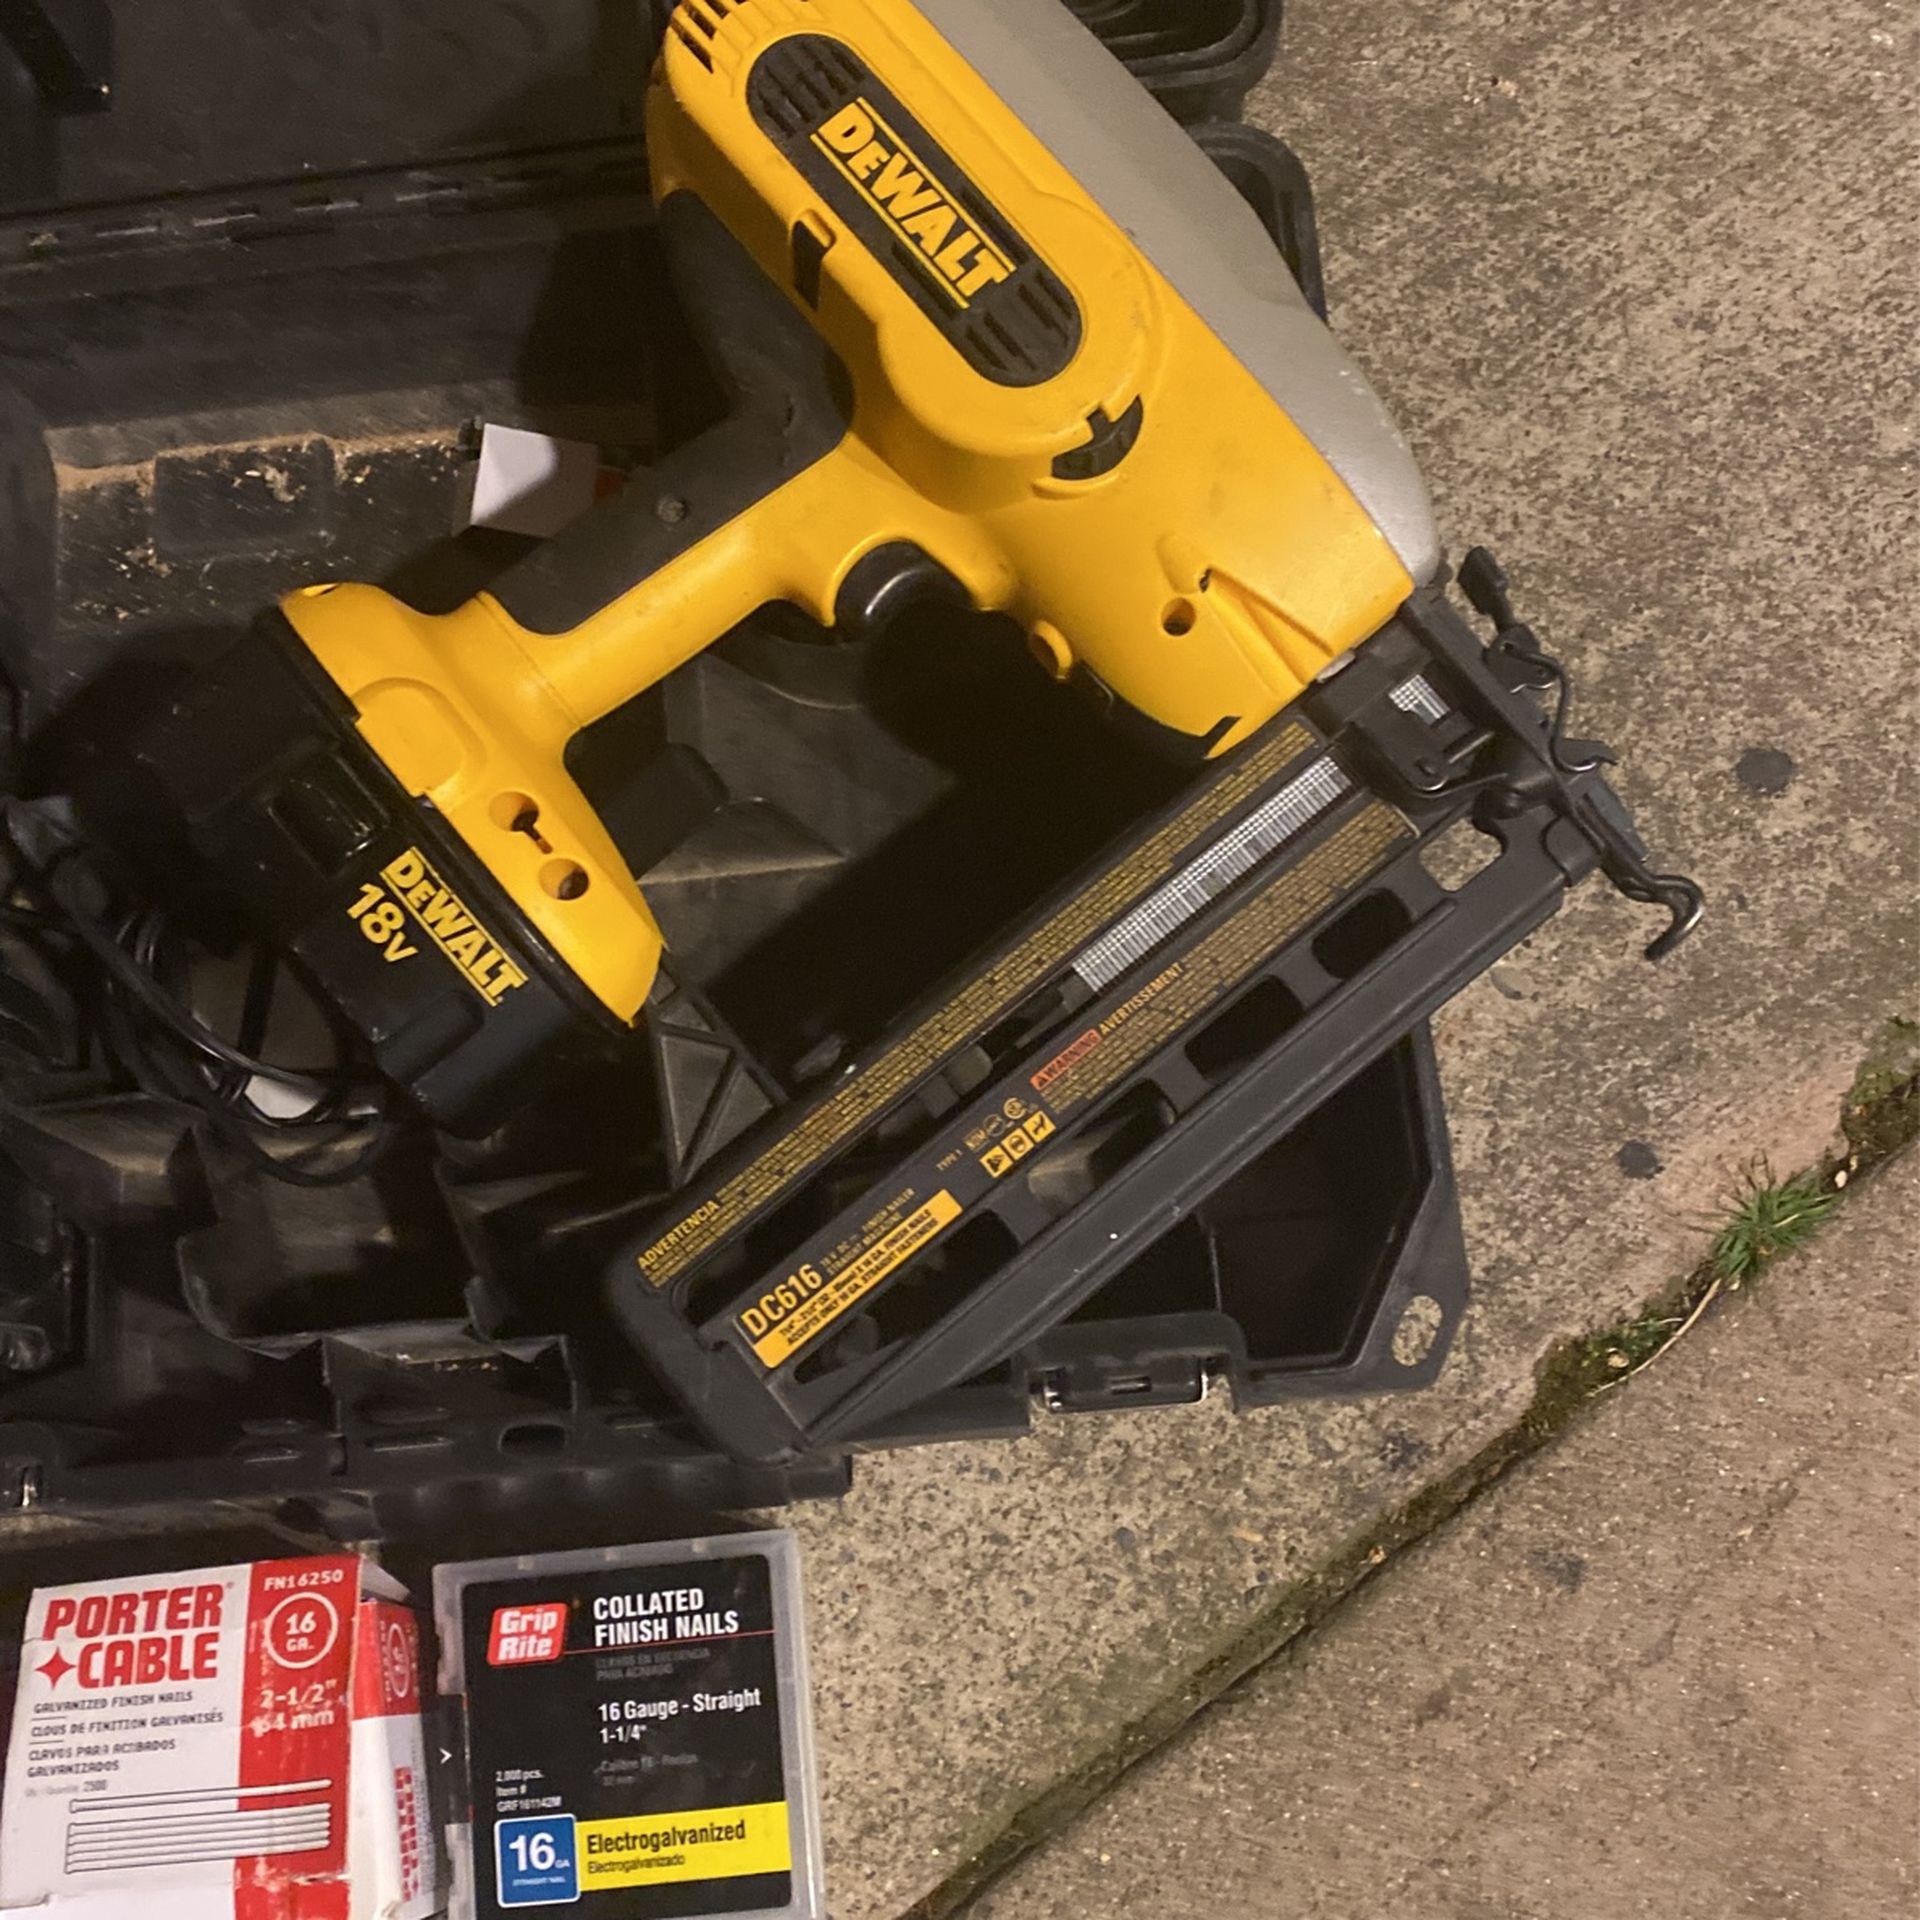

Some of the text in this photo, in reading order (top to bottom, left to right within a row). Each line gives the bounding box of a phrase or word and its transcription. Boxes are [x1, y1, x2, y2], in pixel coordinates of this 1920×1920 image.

[815, 100, 1011, 300] DEWALT
[383, 848, 527, 1000] DEWALT
[1099, 962, 1183, 1035] AVERTISSEMENT
[1044, 1031, 1099, 1080] WARNING
[637, 1199, 721, 1271] ADVERTENCIA
[739, 1261, 824, 1338] DC616
[264, 1569, 344, 1591] FN16250
[43, 1583, 224, 1641] PORTER
[593, 1587, 704, 1621] COLLATED
[286, 1612, 317, 1635] 16
[499, 1609, 558, 1635] Grip
[594, 1610, 739, 1647] FINISH NAILS
[77, 1632, 219, 1689] CABLE
[498, 1636, 553, 1661] Rite
[34, 1691, 193, 1714] GALVANIZED FINISH NAILS
[291, 1710, 335, 1730] mm
[599, 1702, 621, 1722] 16
[624, 1699, 678, 1721] Gauge
[692, 1687, 761, 1714] Straight
[31, 1708, 224, 1737] CLOUS DE FINITION GALVANISÉS
[600, 1724, 647, 1744] 1-1/4"
[27, 1760, 120, 1778] GALVANIZADOS
[508, 1832, 556, 1872] 16
[587, 1819, 746, 1855] Electrogalvanized
[588, 1853, 685, 1875] Electrogalvanizado
